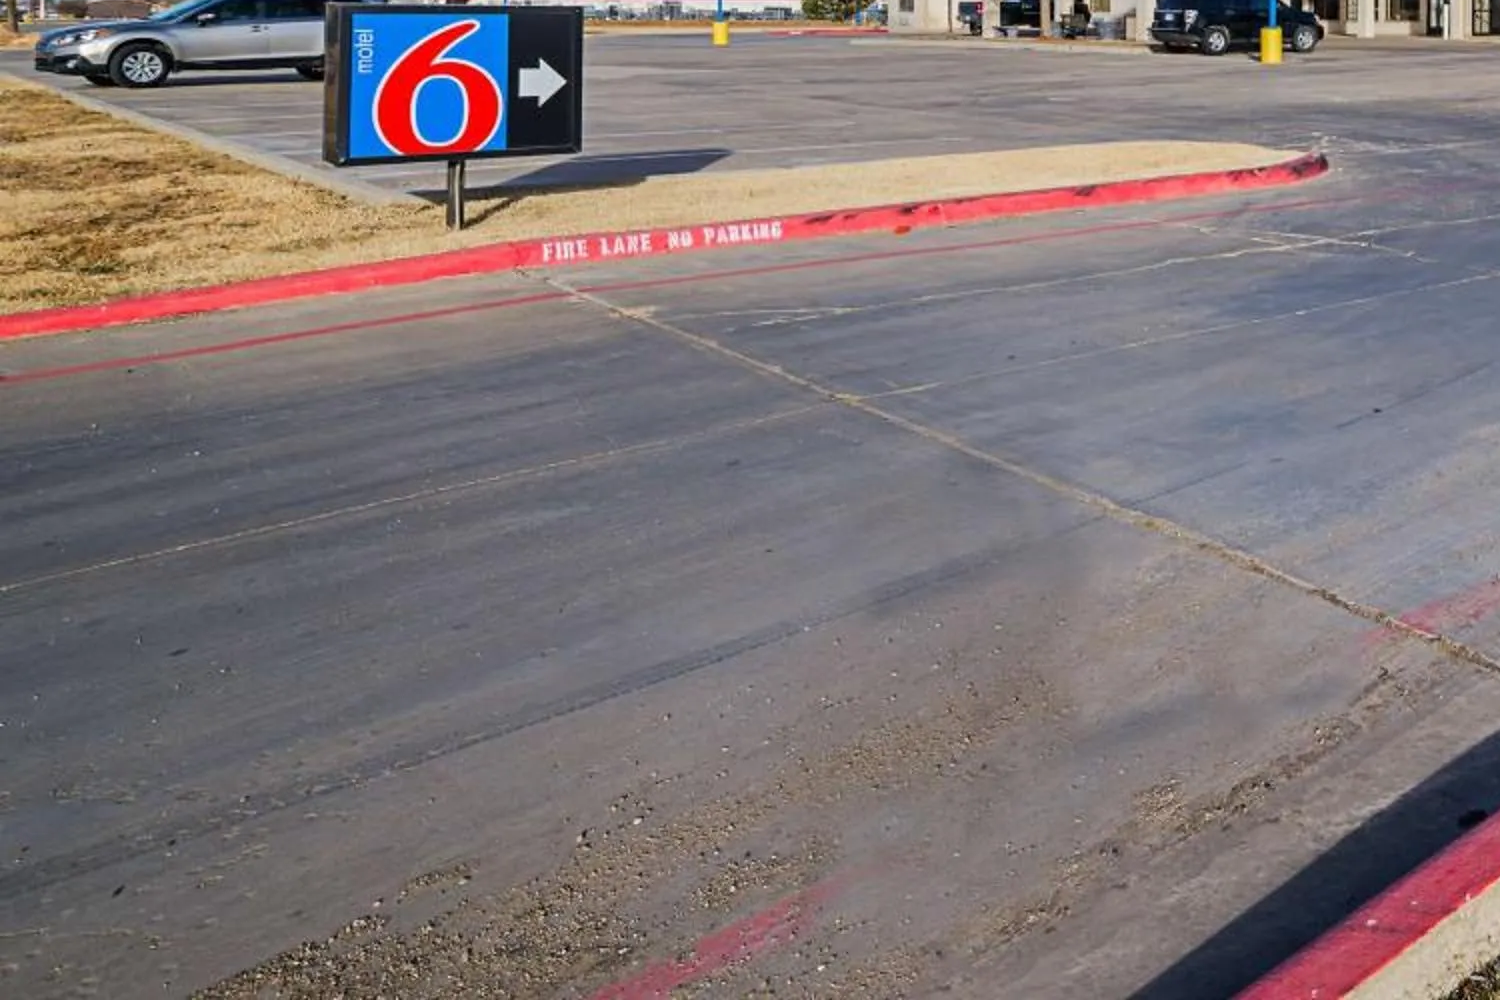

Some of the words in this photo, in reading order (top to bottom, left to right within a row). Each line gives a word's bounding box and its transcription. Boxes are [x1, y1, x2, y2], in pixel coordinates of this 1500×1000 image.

[354, 29, 374, 73] motel
[372, 19, 503, 156] 6
[543, 240, 589, 261] FIRE
[600, 233, 651, 255] LANE
[667, 229, 694, 249] NO
[703, 221, 782, 243] PARKING
